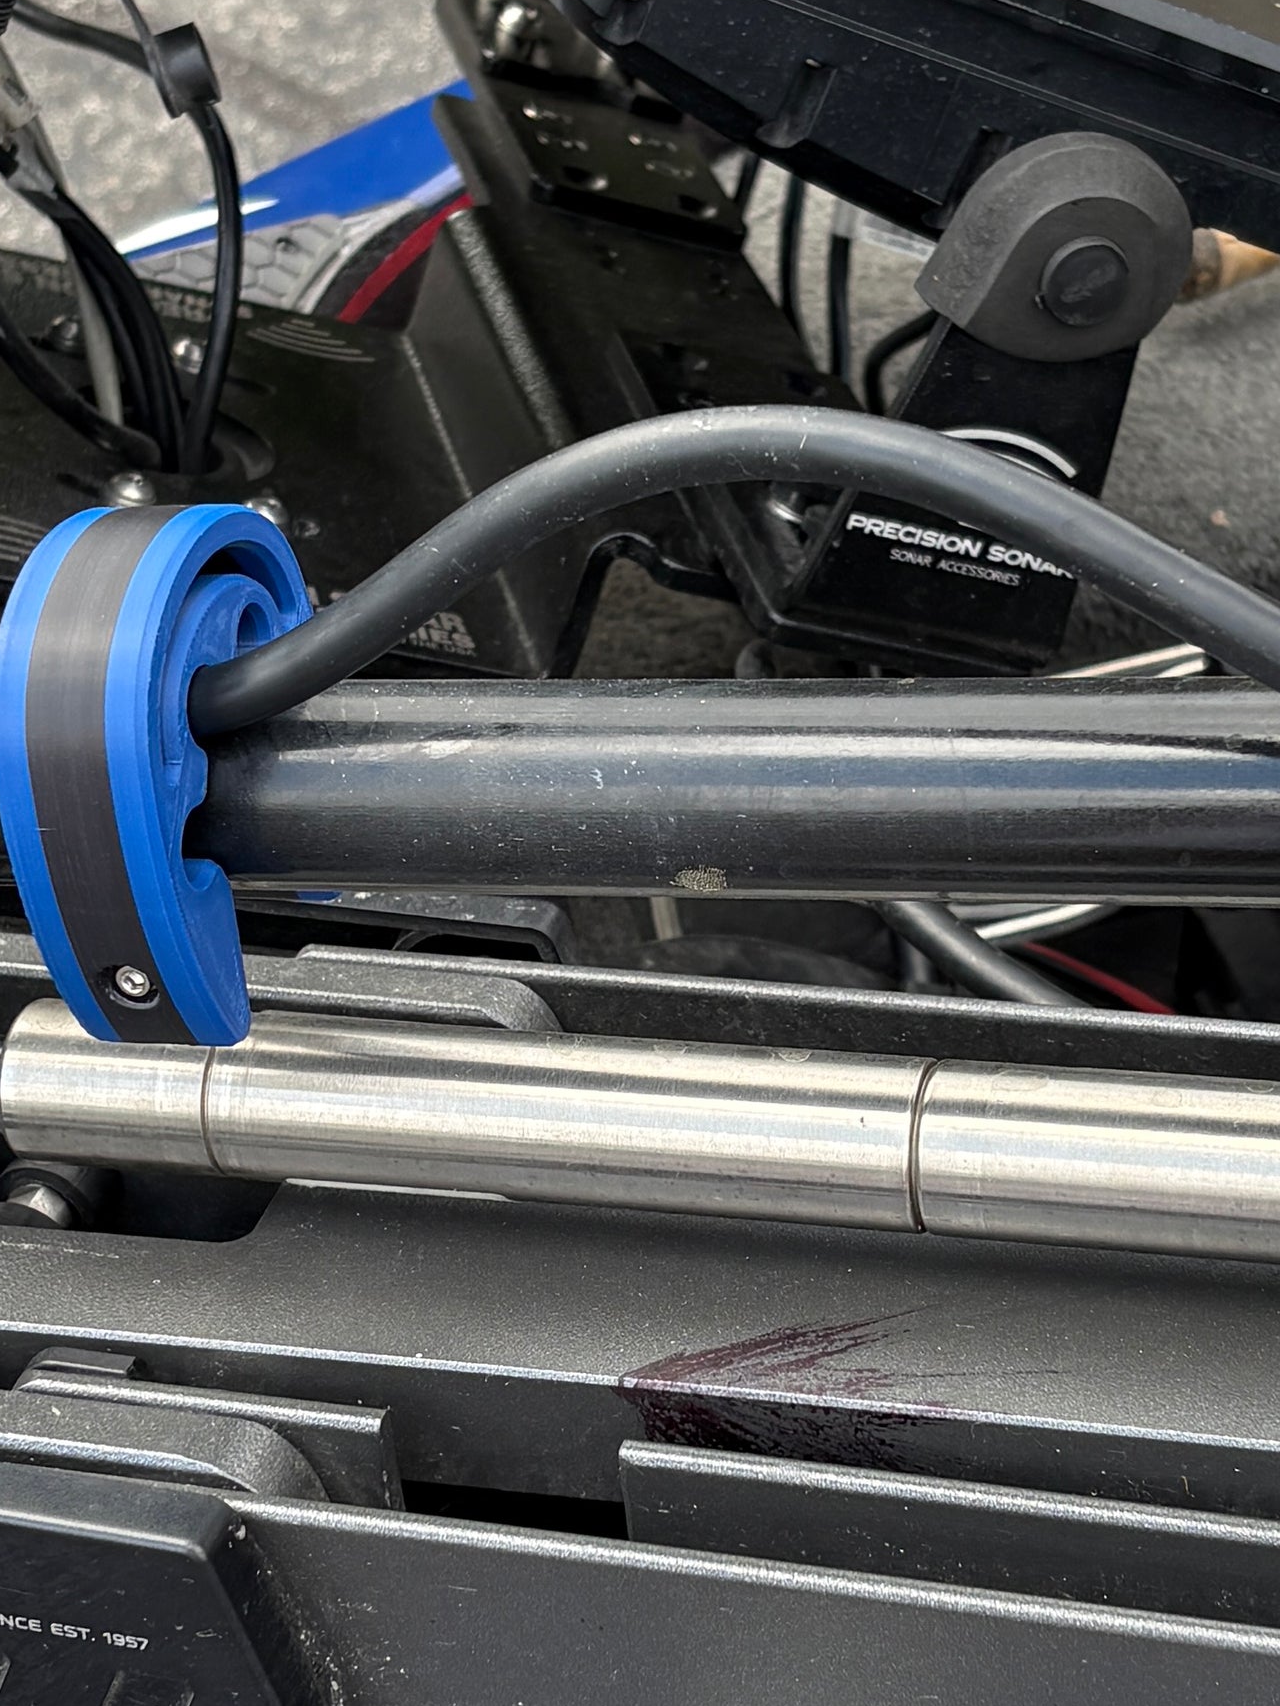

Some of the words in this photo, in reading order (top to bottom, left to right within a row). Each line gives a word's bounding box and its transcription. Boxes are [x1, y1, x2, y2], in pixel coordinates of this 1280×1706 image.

[846, 513, 982, 558] PRECISION
[889, 548, 932, 568] SONAR
[936, 559, 1021, 587] ACCESSORIES
[50, 1622, 96, 1642] EST.
[102, 1631, 149, 1651] 1957
